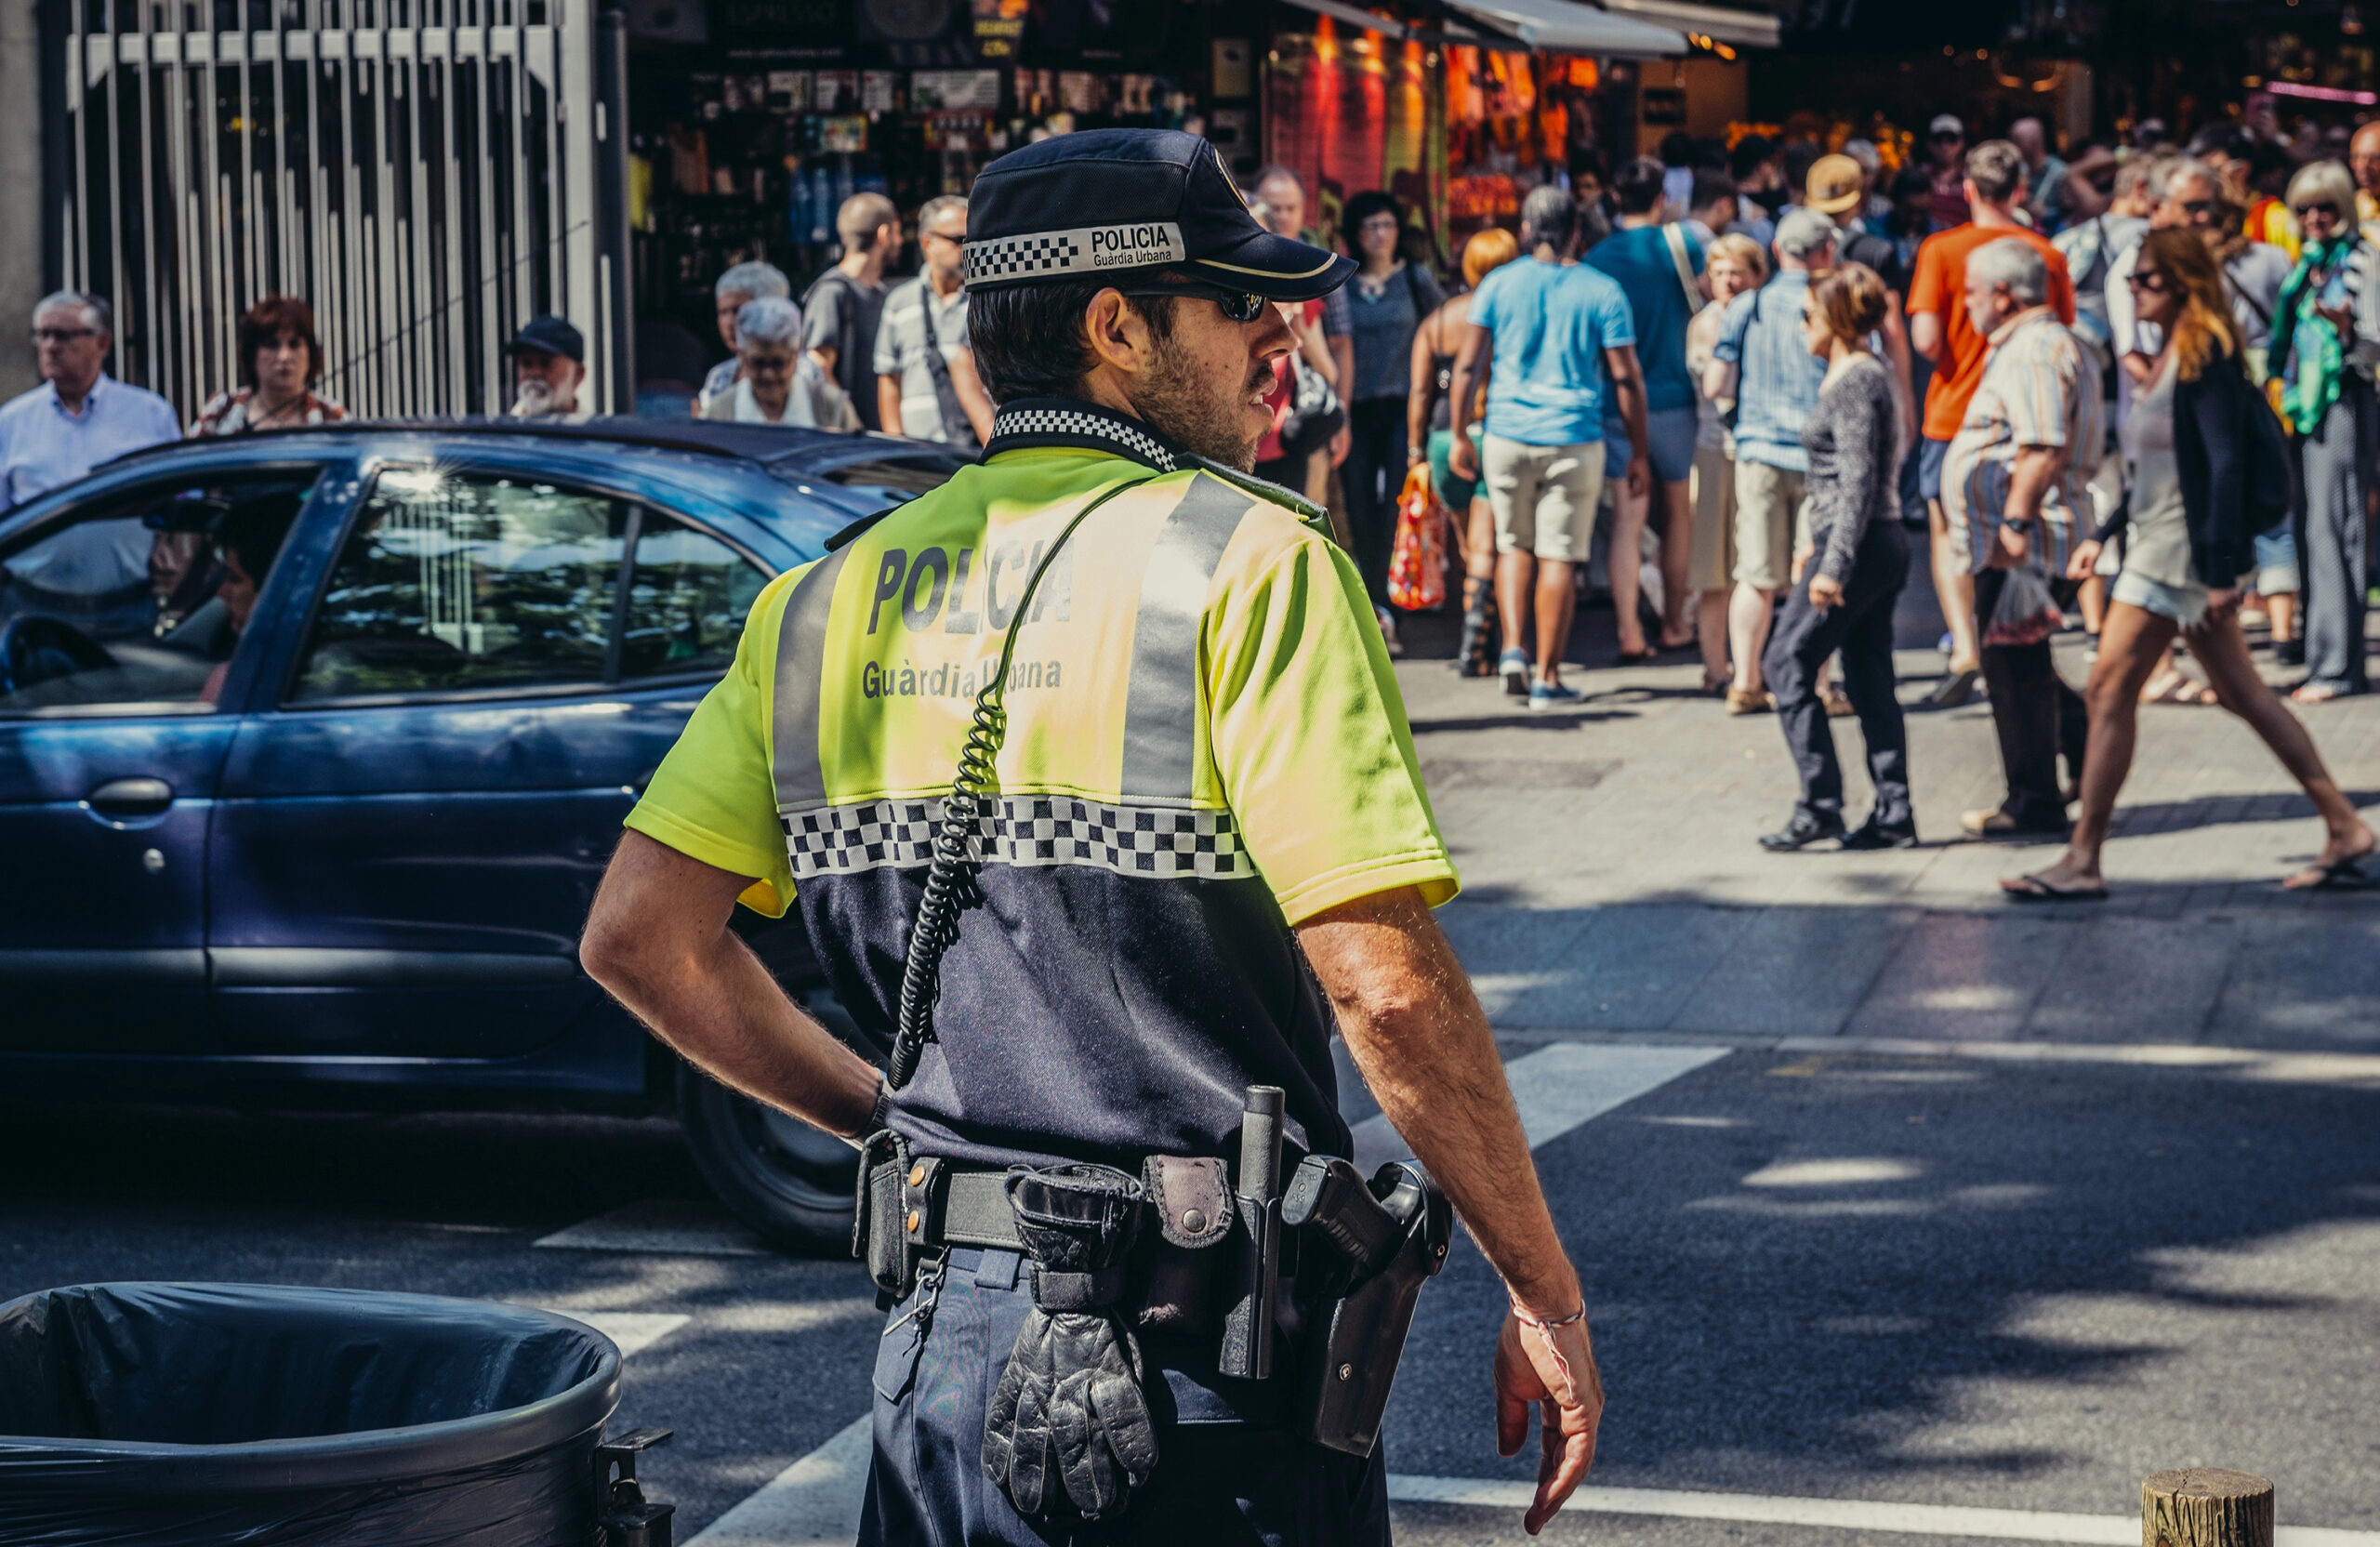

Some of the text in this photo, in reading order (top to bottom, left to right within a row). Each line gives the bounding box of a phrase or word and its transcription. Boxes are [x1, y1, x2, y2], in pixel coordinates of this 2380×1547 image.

[1091, 226, 1170, 252] POLICIA
[1093, 250, 1171, 267] Guàrdia Urbana
[866, 537, 1075, 635] POLCIA
[863, 657, 1062, 698] Guàrdia Ubana
